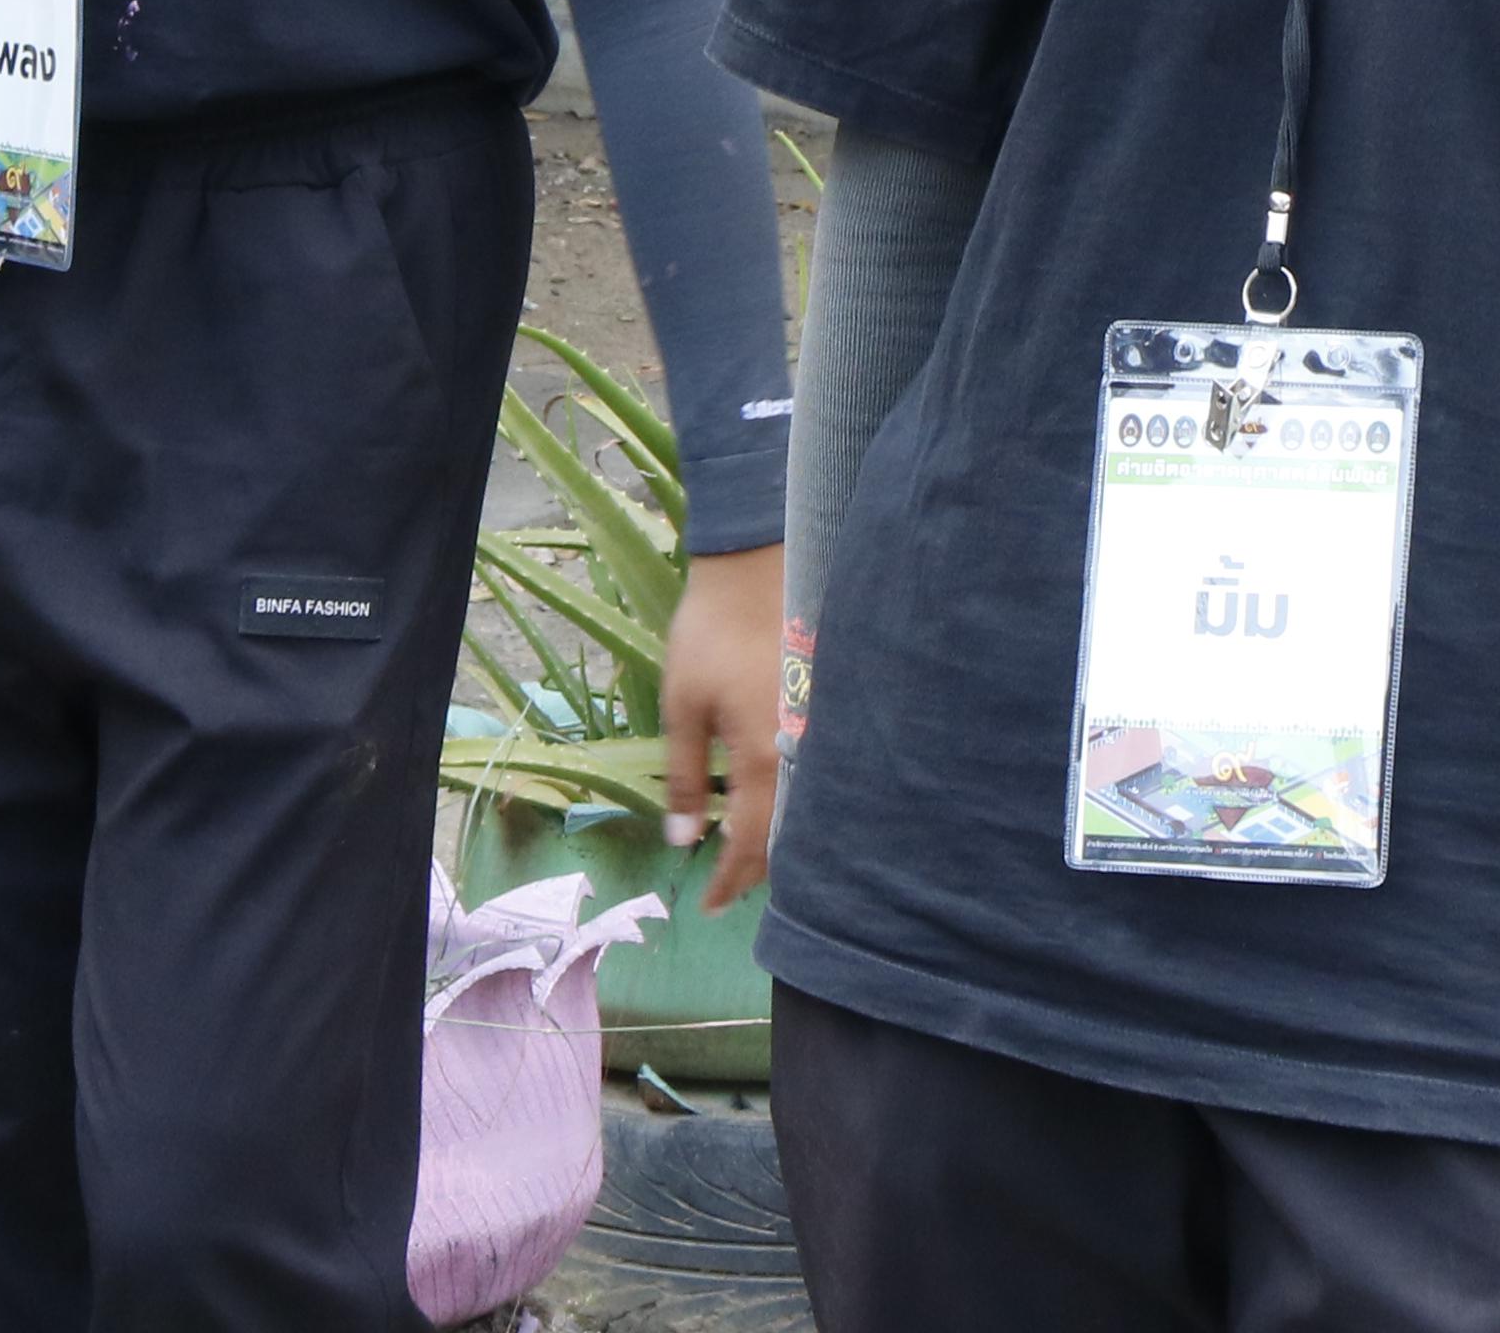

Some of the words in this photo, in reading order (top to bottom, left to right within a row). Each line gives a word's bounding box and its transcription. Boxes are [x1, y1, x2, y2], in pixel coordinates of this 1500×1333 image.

[255, 597, 302, 615] BINFA
[304, 599, 371, 618] FASHION
[1193, 554, 1290, 639] มิ้ม
